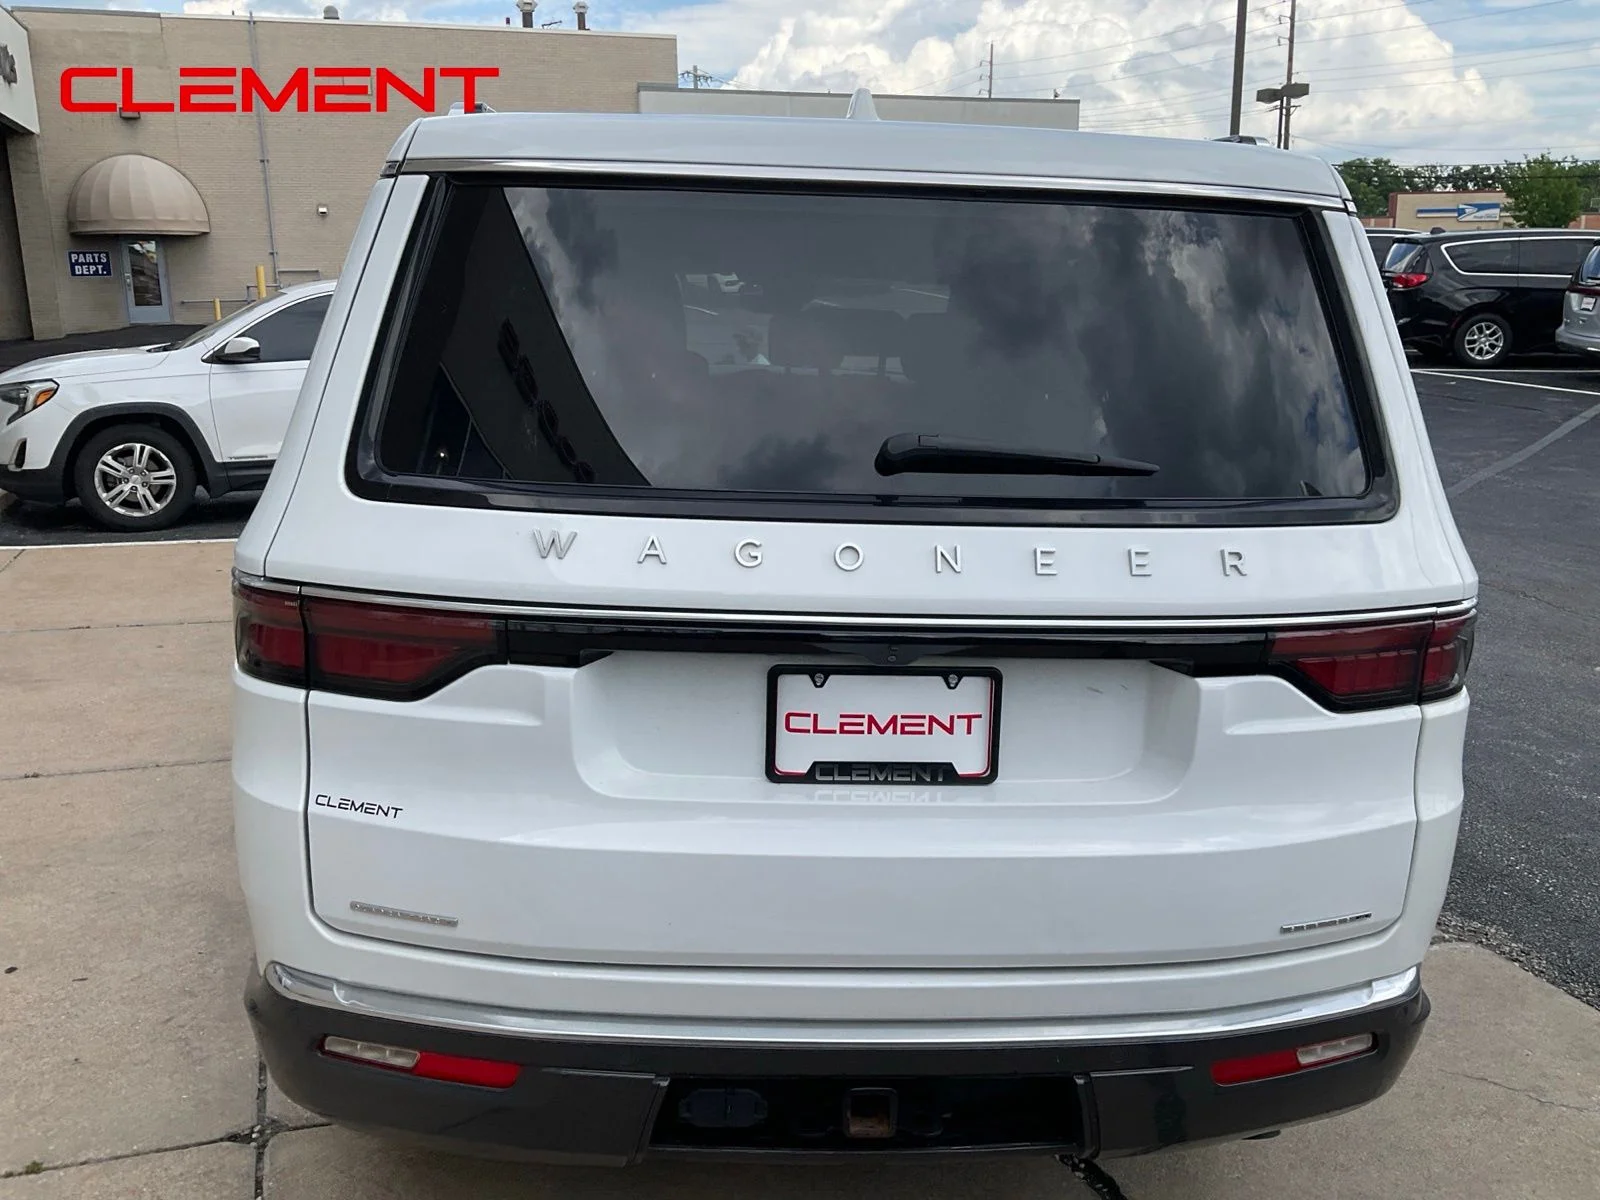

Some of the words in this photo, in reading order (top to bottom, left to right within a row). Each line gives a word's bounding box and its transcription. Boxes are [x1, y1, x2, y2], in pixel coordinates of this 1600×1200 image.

[71, 253, 107, 263] PARTS
[75, 265, 107, 275] DEPT.
[533, 528, 1247, 577] WAGONEER
[784, 711, 983, 735] CLEMENT
[815, 764, 947, 782] CLEMENT
[315, 794, 403, 819] CLEMENT
